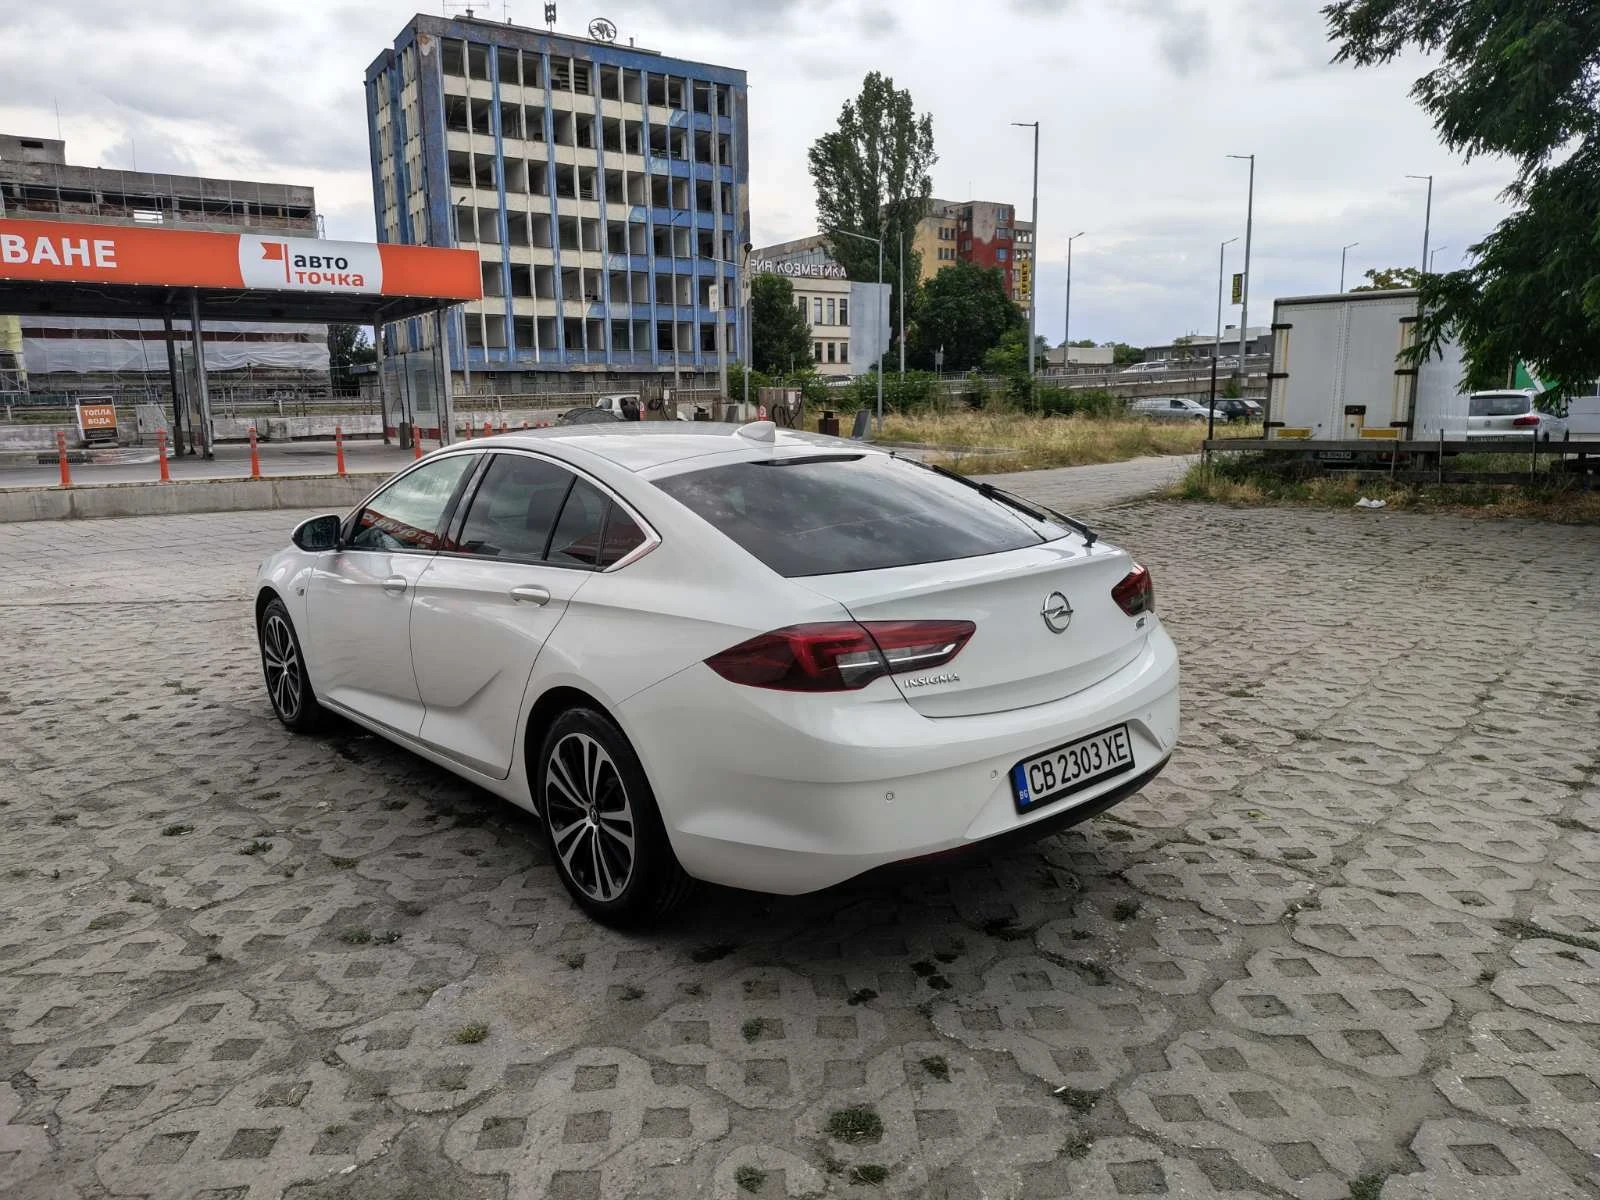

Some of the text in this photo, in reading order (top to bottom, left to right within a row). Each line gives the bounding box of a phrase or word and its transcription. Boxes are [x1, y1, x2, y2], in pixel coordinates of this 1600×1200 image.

[0, 234, 118, 268] ВАНЕ
[294, 254, 348, 270] авто
[777, 262, 848, 278] КОЗМЕТИКА
[295, 271, 364, 287] точка
[84, 408, 112, 417] ТОПЛА
[88, 417, 111, 425] ВОДА
[904, 672, 961, 688] INSIGNIA
[1029, 732, 1128, 794] CB 2303 XE
[1019, 789, 1029, 800] BG
